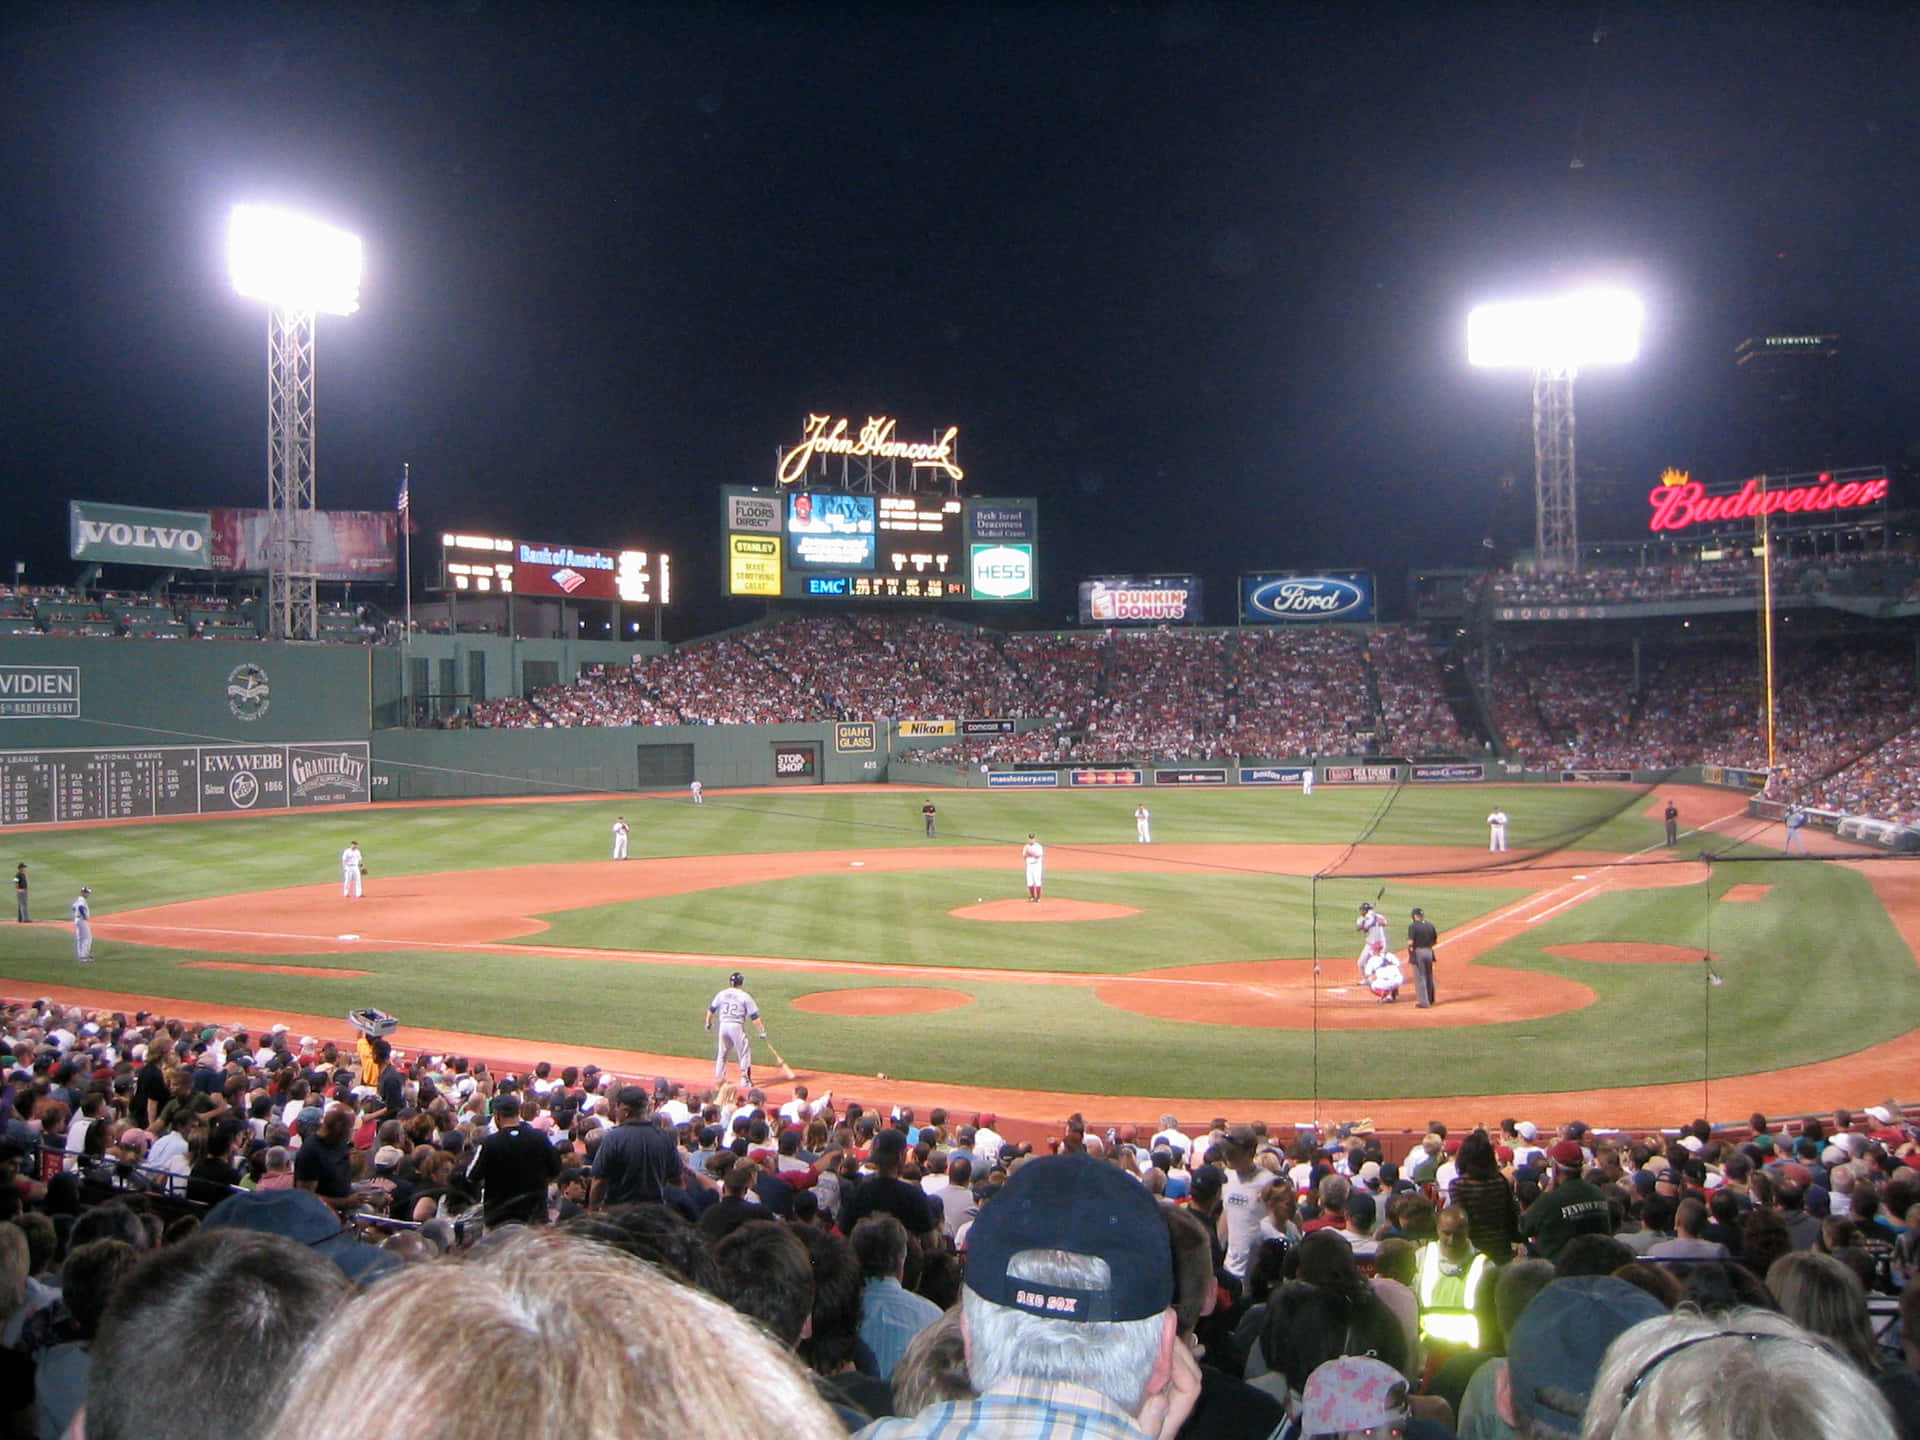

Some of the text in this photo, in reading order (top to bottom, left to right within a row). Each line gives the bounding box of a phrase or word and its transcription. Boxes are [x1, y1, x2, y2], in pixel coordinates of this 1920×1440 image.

[779, 413, 964, 483] John Hancock
[1650, 472, 1889, 531] Budweiser
[735, 507, 775, 518] FLOORS
[977, 511, 1022, 520] Beth Israel
[736, 518, 770, 527] DIRECT
[977, 521, 1023, 529] Deaconess
[80, 520, 202, 551] VOLVO
[737, 542, 774, 553] STANLEY
[520, 544, 614, 570] Bank of America
[977, 565, 1026, 579] HESS
[1118, 591, 1187, 604] DUNKIN'
[1274, 583, 1340, 610] Ford
[1118, 606, 1184, 617] DONUTS
[840, 727, 871, 737] GIANT
[910, 723, 944, 734] Nikon
[840, 738, 872, 747] GLASS
[236, 753, 283, 770] WEBB
[777, 753, 803, 765] STOP
[723, 1002, 738, 1016] 32
[1016, 1290, 1078, 1312] RED SOX
